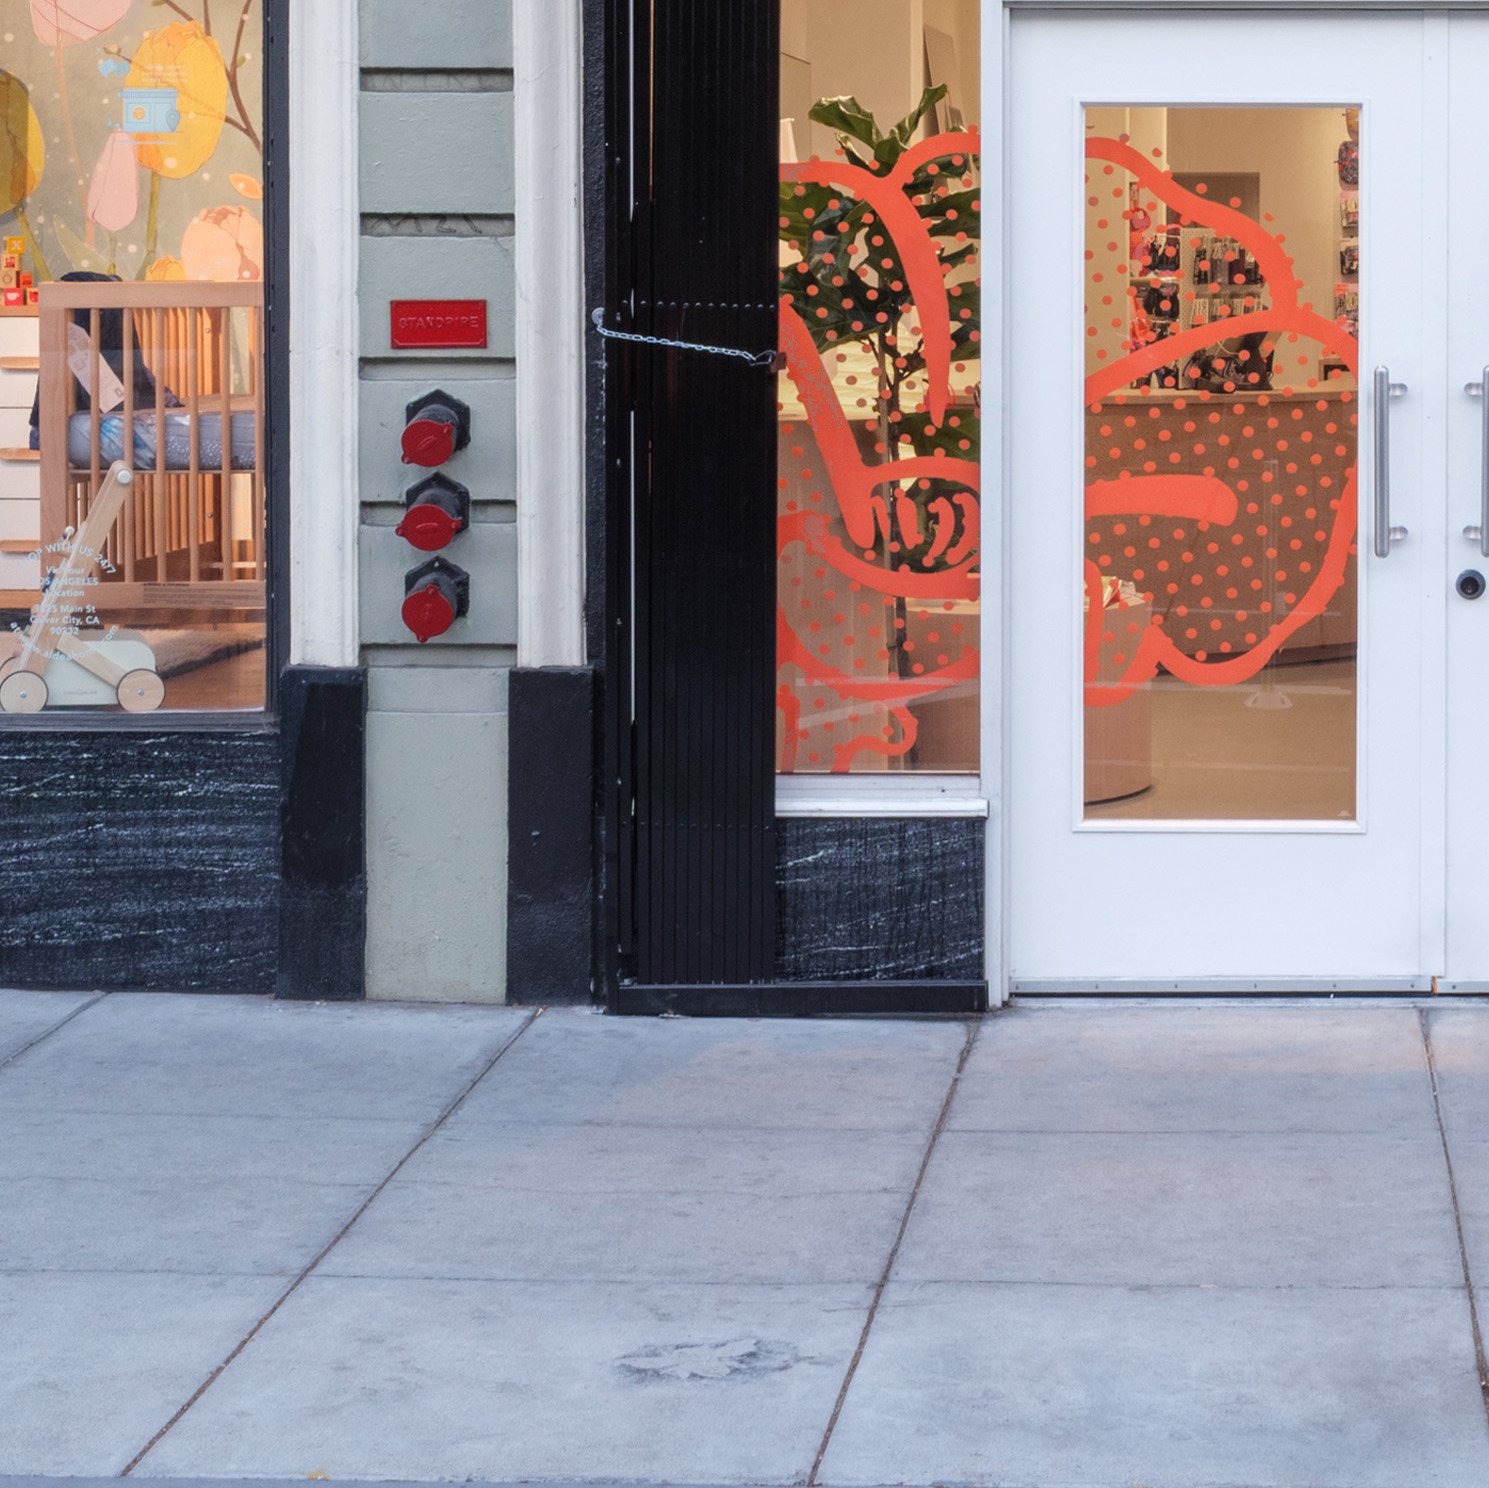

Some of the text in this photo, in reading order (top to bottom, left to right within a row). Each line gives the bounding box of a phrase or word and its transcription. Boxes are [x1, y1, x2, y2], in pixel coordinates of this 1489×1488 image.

[398, 316, 479, 329] STANDPIPE
[78, 545, 94, 557] US
[60, 604, 83, 612] Main
[85, 604, 96, 612] St
[62, 615, 83, 625] City,
[85, 615, 100, 624] CA
